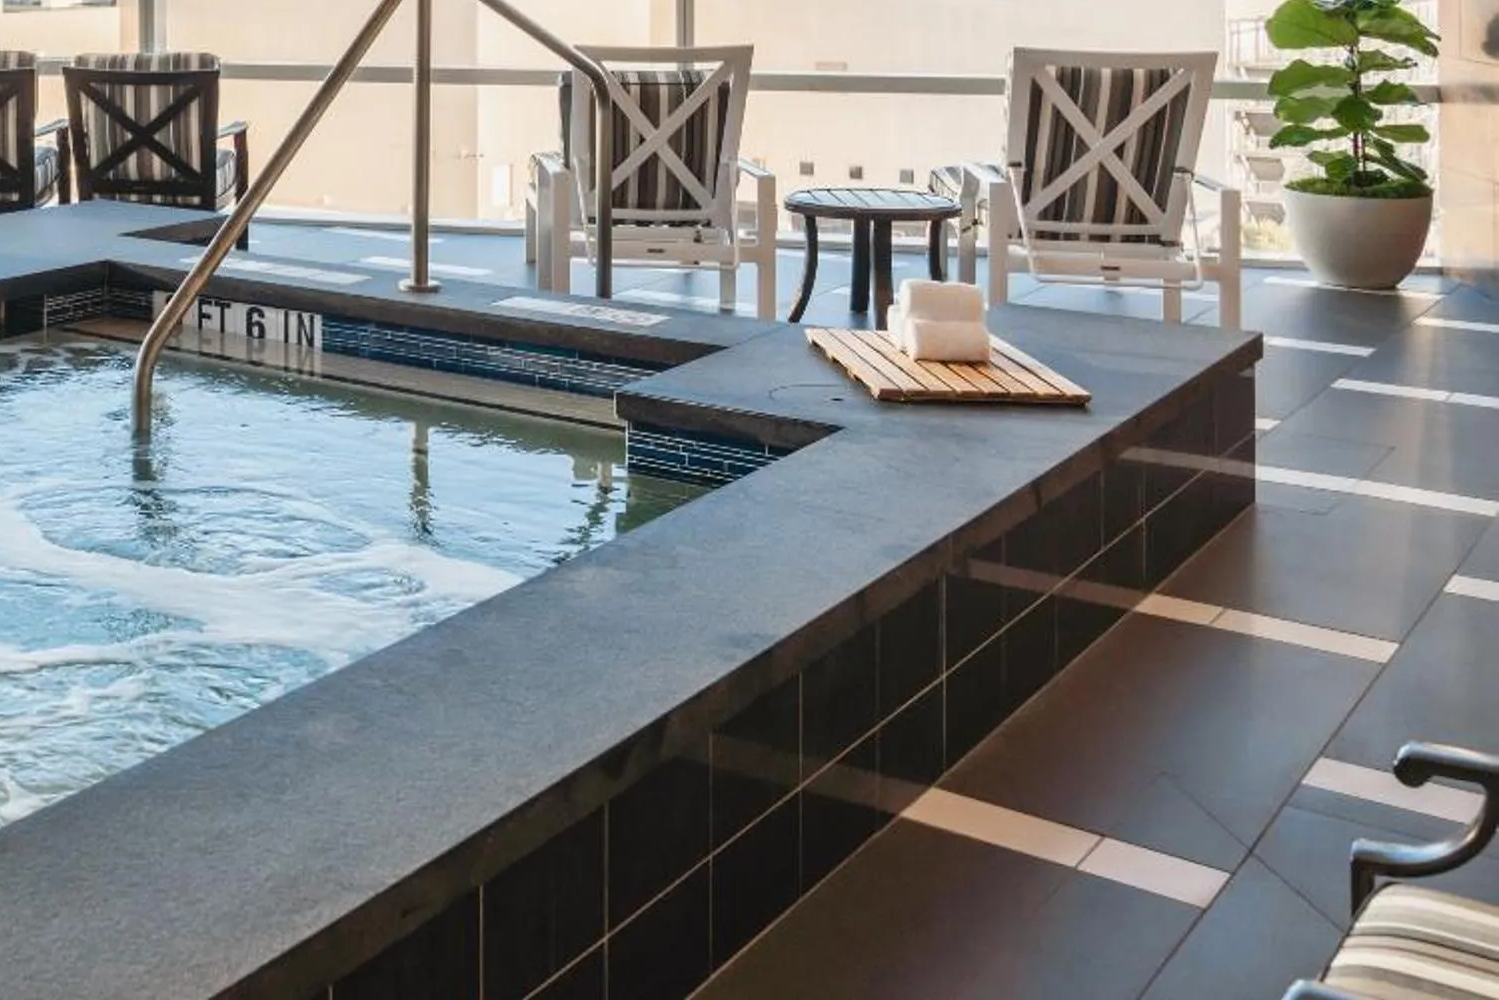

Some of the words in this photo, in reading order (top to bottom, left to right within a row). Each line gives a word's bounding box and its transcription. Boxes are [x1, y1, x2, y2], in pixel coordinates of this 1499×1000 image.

[198, 298, 231, 334] FT
[246, 306, 266, 339] 6
[284, 310, 315, 347] IN
